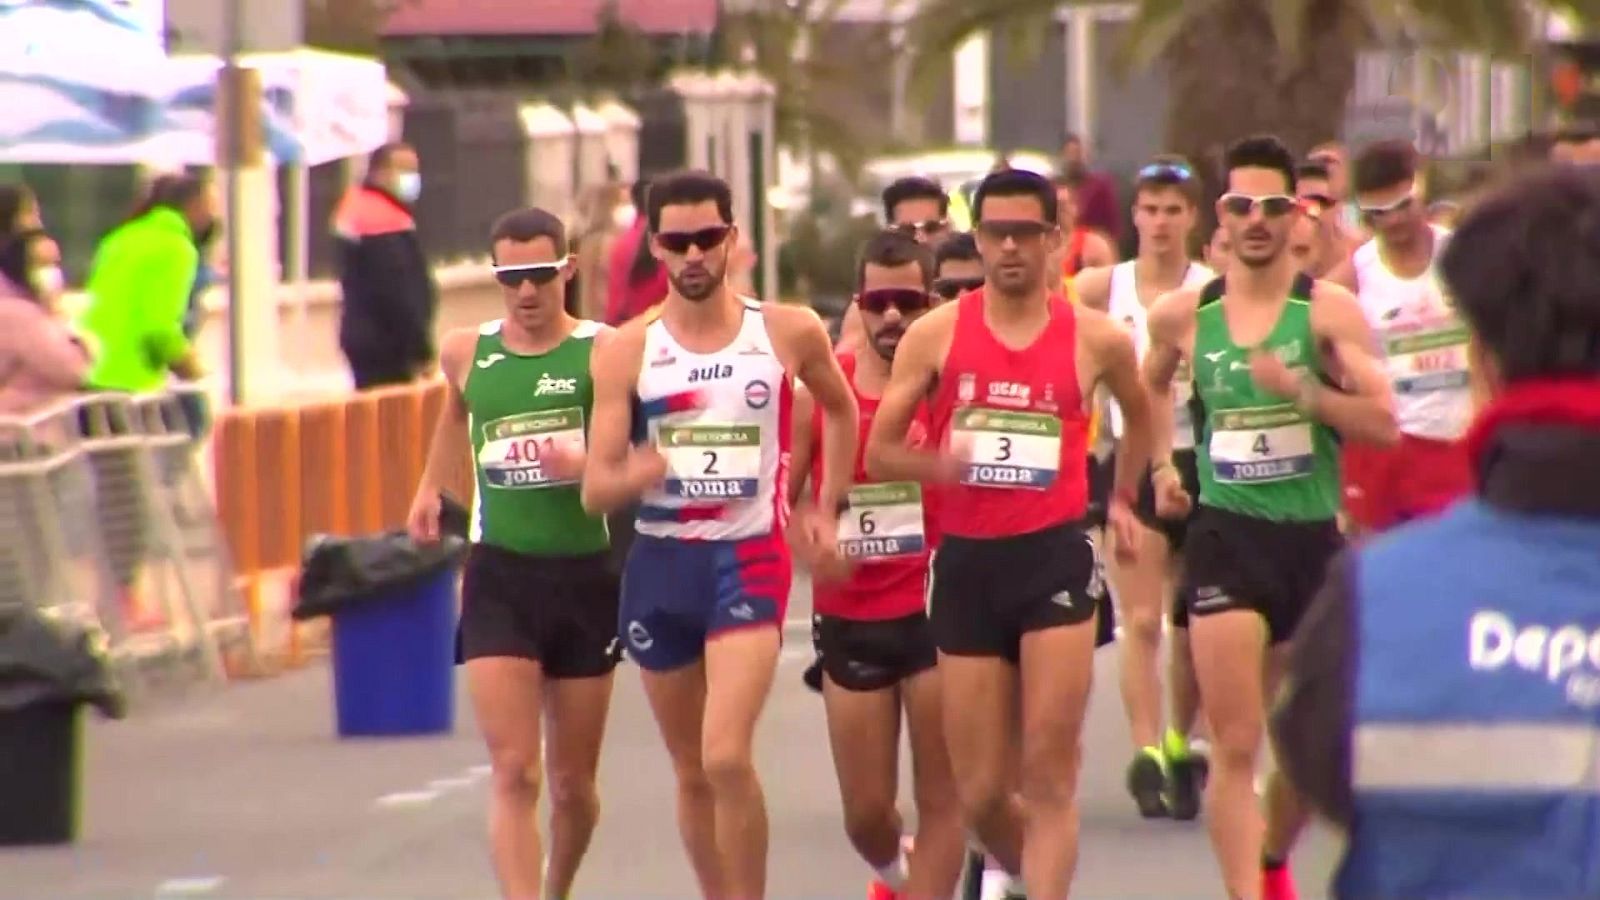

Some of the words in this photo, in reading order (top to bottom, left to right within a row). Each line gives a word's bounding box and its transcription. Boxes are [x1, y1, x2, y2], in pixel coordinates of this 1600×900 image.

[688, 363, 734, 384] aula
[994, 437, 1012, 461] 3
[1252, 432, 1270, 456] 4
[702, 450, 719, 475] 2
[859, 511, 876, 535] 6
